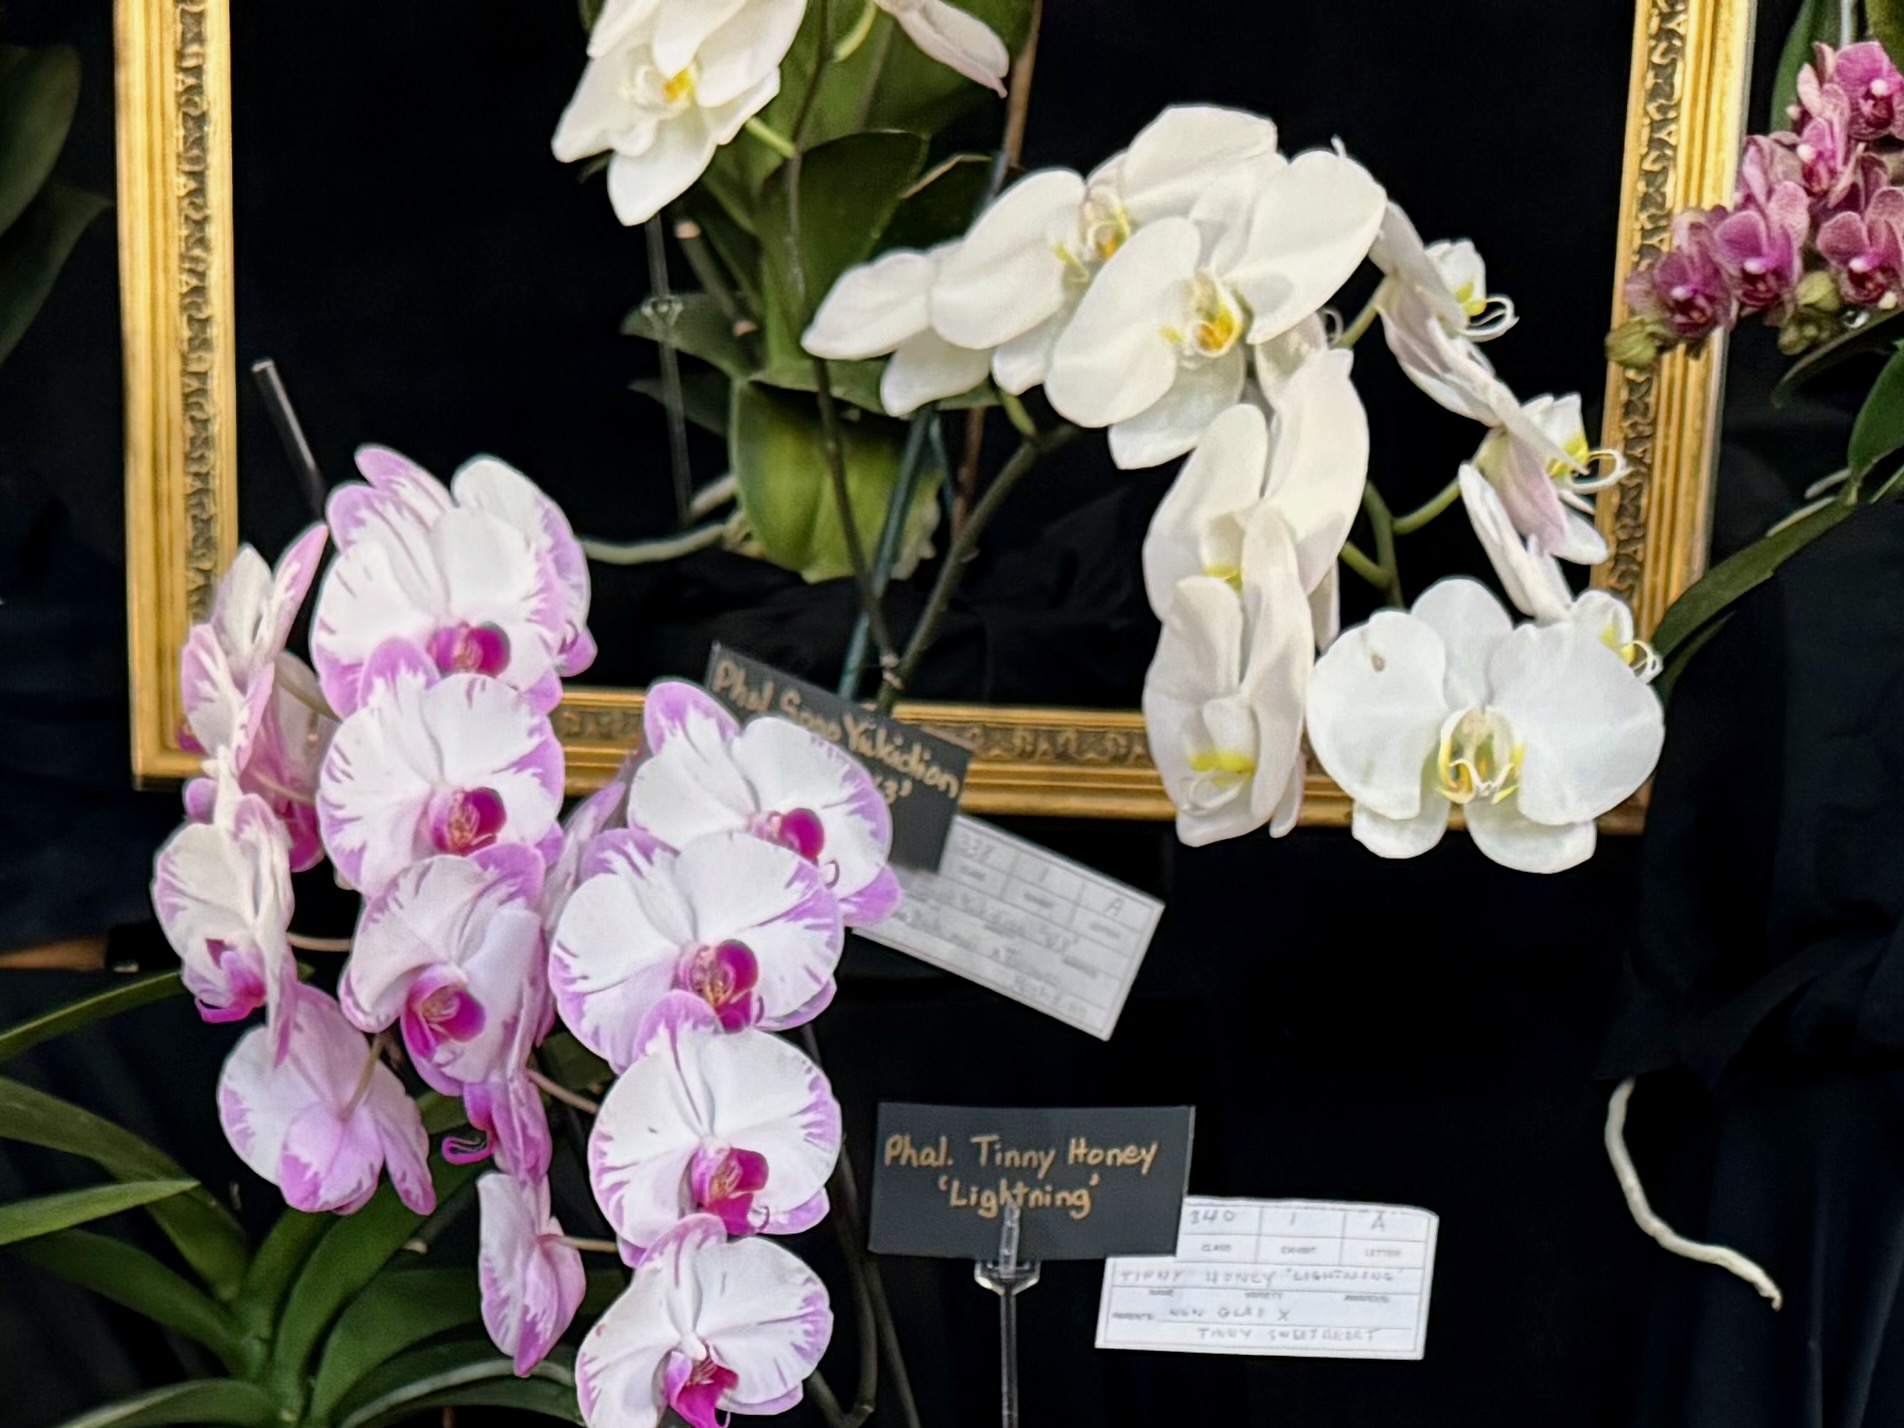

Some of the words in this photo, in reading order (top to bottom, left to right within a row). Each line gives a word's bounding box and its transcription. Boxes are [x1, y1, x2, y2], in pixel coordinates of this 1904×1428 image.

[885, 1133, 954, 1168] Phal.
[970, 1135, 1056, 1180] Tinny
[1067, 1136, 1159, 1175] Honey
